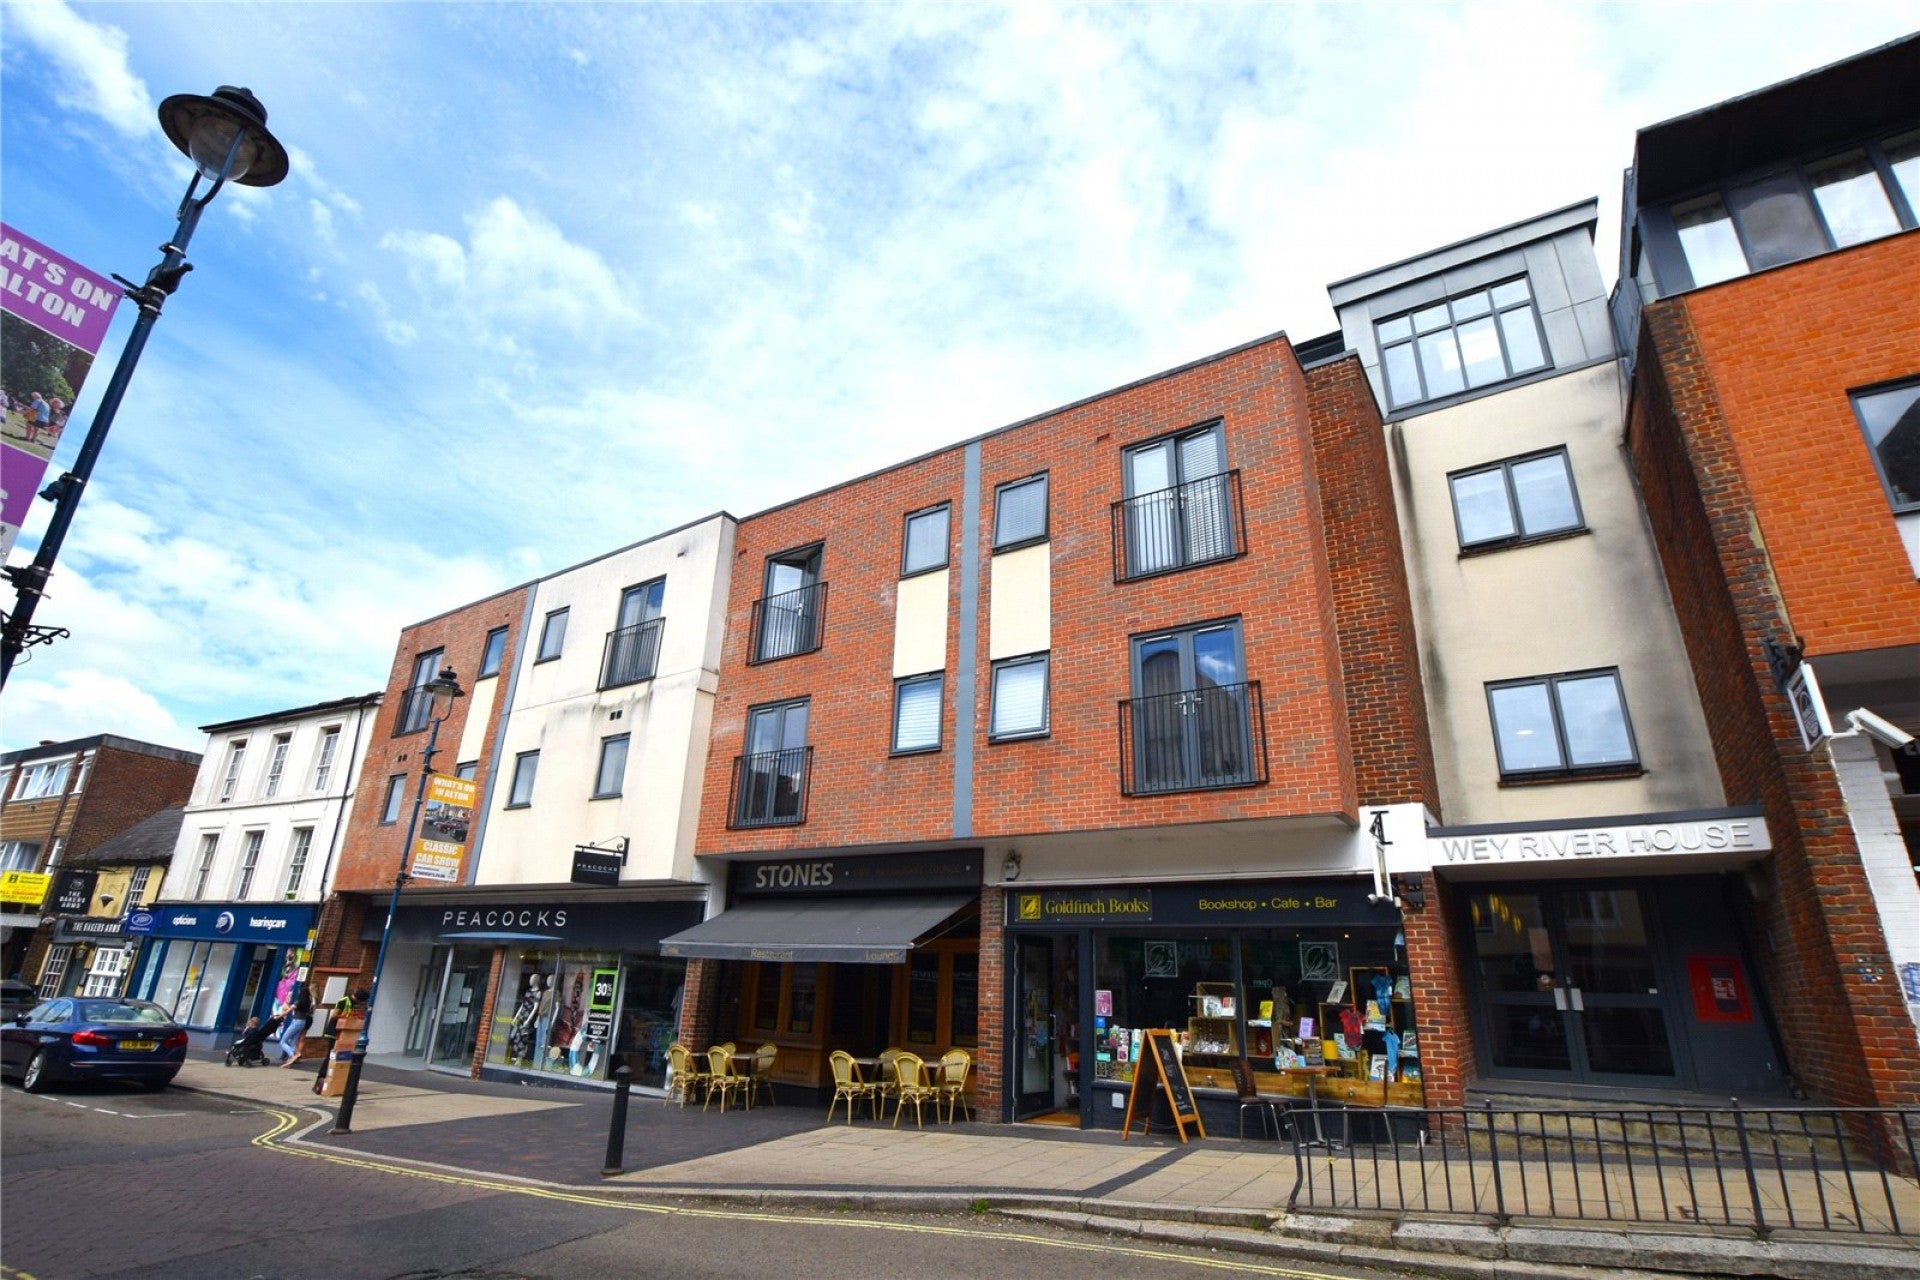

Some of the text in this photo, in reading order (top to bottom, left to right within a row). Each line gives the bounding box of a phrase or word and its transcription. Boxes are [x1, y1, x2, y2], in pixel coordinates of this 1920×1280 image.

[70, 277, 115, 312] ON
[444, 789, 469, 800] ALTON
[423, 841, 458, 854] CLASSIC
[1442, 823, 1754, 861] WEY RIVER HOUSE
[415, 852, 460, 867] CAR SHOW
[576, 863, 618, 872] PEACOCKS
[755, 863, 834, 888] STONES
[1045, 898, 1150, 915] Goldfinch Books
[1199, 896, 1338, 912] Bookshop Cafe Bar
[172, 914, 197, 926] opticians
[249, 916, 287, 930] hearingcare
[442, 910, 568, 927] PEACOCKS
[72, 922, 121, 933] THE BAKERS ARMS
